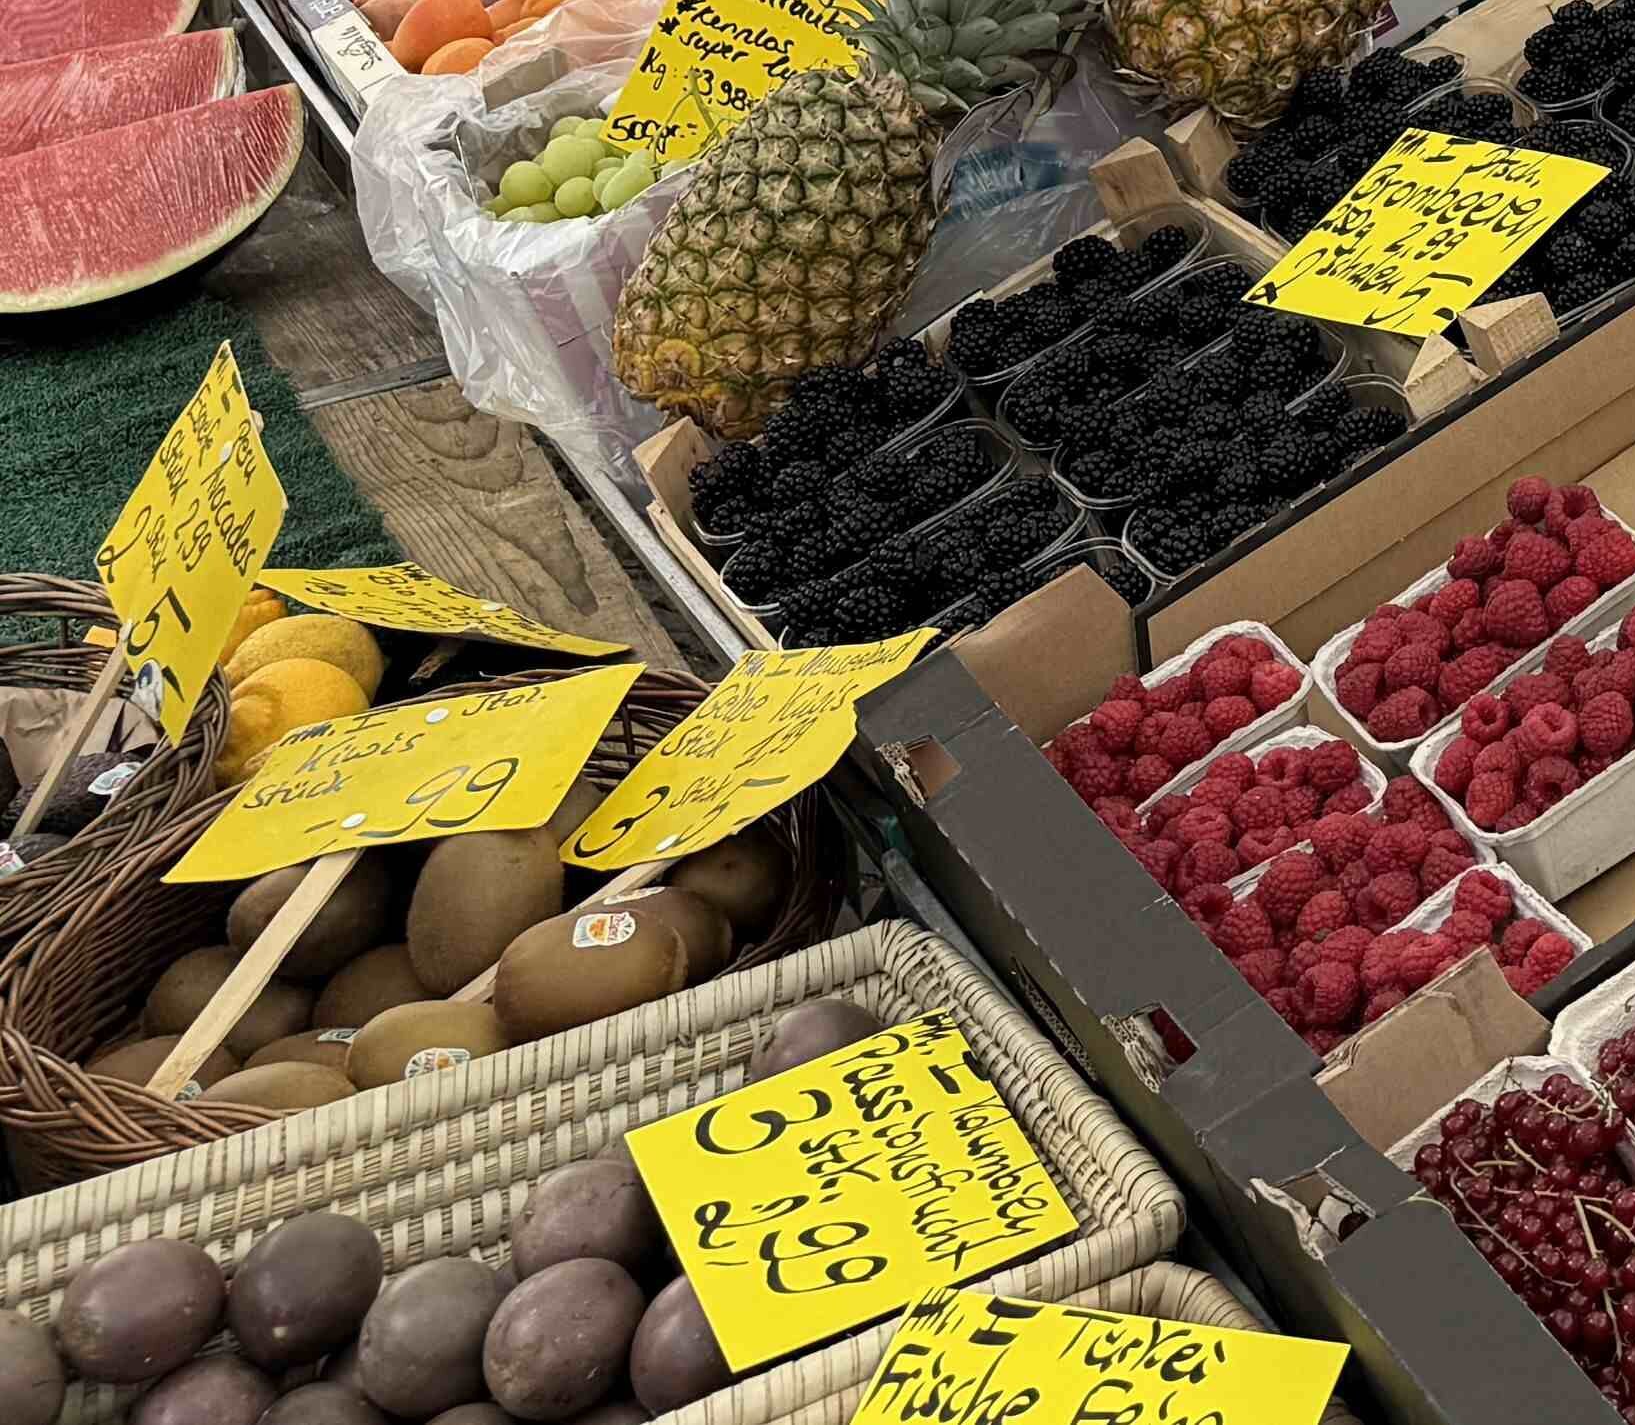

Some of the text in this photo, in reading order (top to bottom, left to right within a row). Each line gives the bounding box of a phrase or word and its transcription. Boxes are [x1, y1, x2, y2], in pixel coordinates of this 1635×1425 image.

[679, 28, 750, 63] super
[1423, 137, 1478, 164] I
[1383, 221, 1469, 262] 2,99
[1247, 247, 1327, 305] 2
[96, 504, 152, 584] 2
[173, 497, 213, 573] 2,99
[341, 707, 401, 734] I
[691, 677, 860, 724] Gelbe Kiwis
[292, 731, 427, 776] Kiwis
[659, 722, 736, 760] Stück
[241, 770, 354, 811] Stück
[573, 785, 671, 859] 3
[928, 1050, 993, 1096] I
[693, 1089, 833, 1156] 3
[830, 1033, 994, 1273] Passionsfrucht
[948, 1094, 1050, 1239] Kolumbien
[967, 1296, 1045, 1346] I
